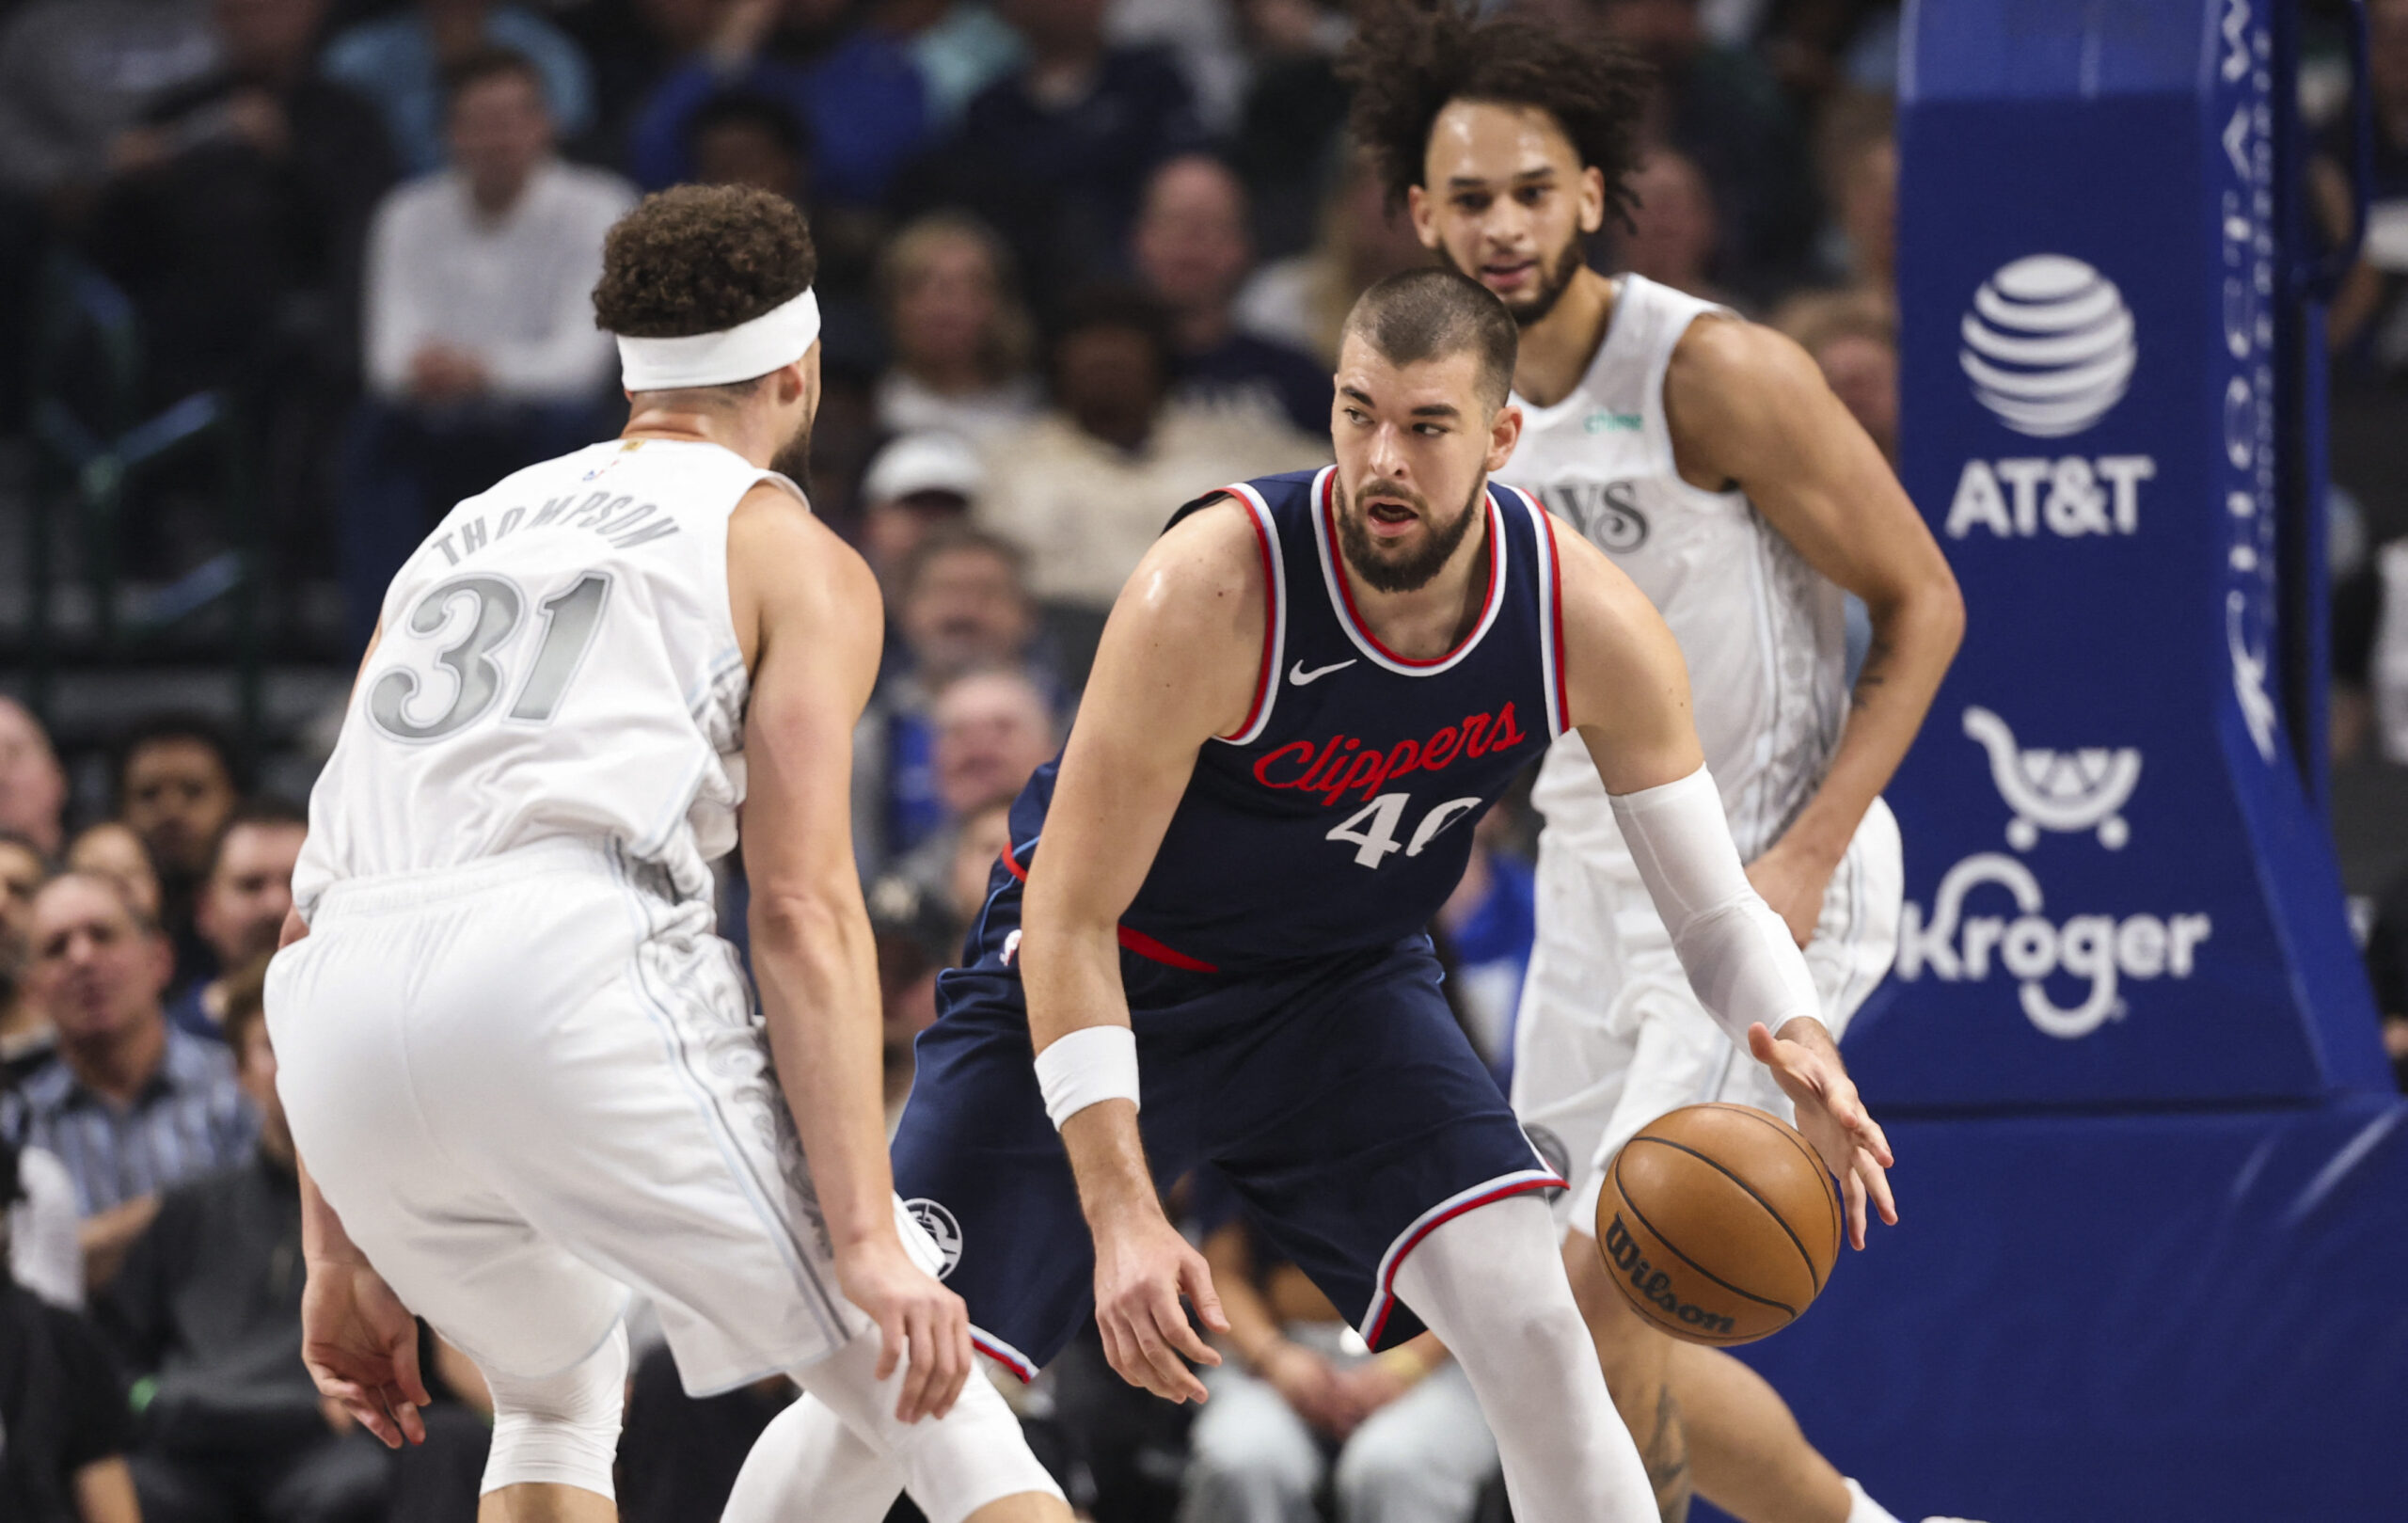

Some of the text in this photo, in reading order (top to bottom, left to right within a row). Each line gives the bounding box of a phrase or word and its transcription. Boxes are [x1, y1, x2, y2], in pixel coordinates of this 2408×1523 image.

[431, 490, 681, 566] THOMPSON
[1944, 454, 2157, 539] AT&T
[364, 569, 615, 746] 31
[1253, 701, 1527, 807] Clippers
[1896, 851, 2212, 1039] Kroger
[1606, 1211, 1736, 1334] Wilson
